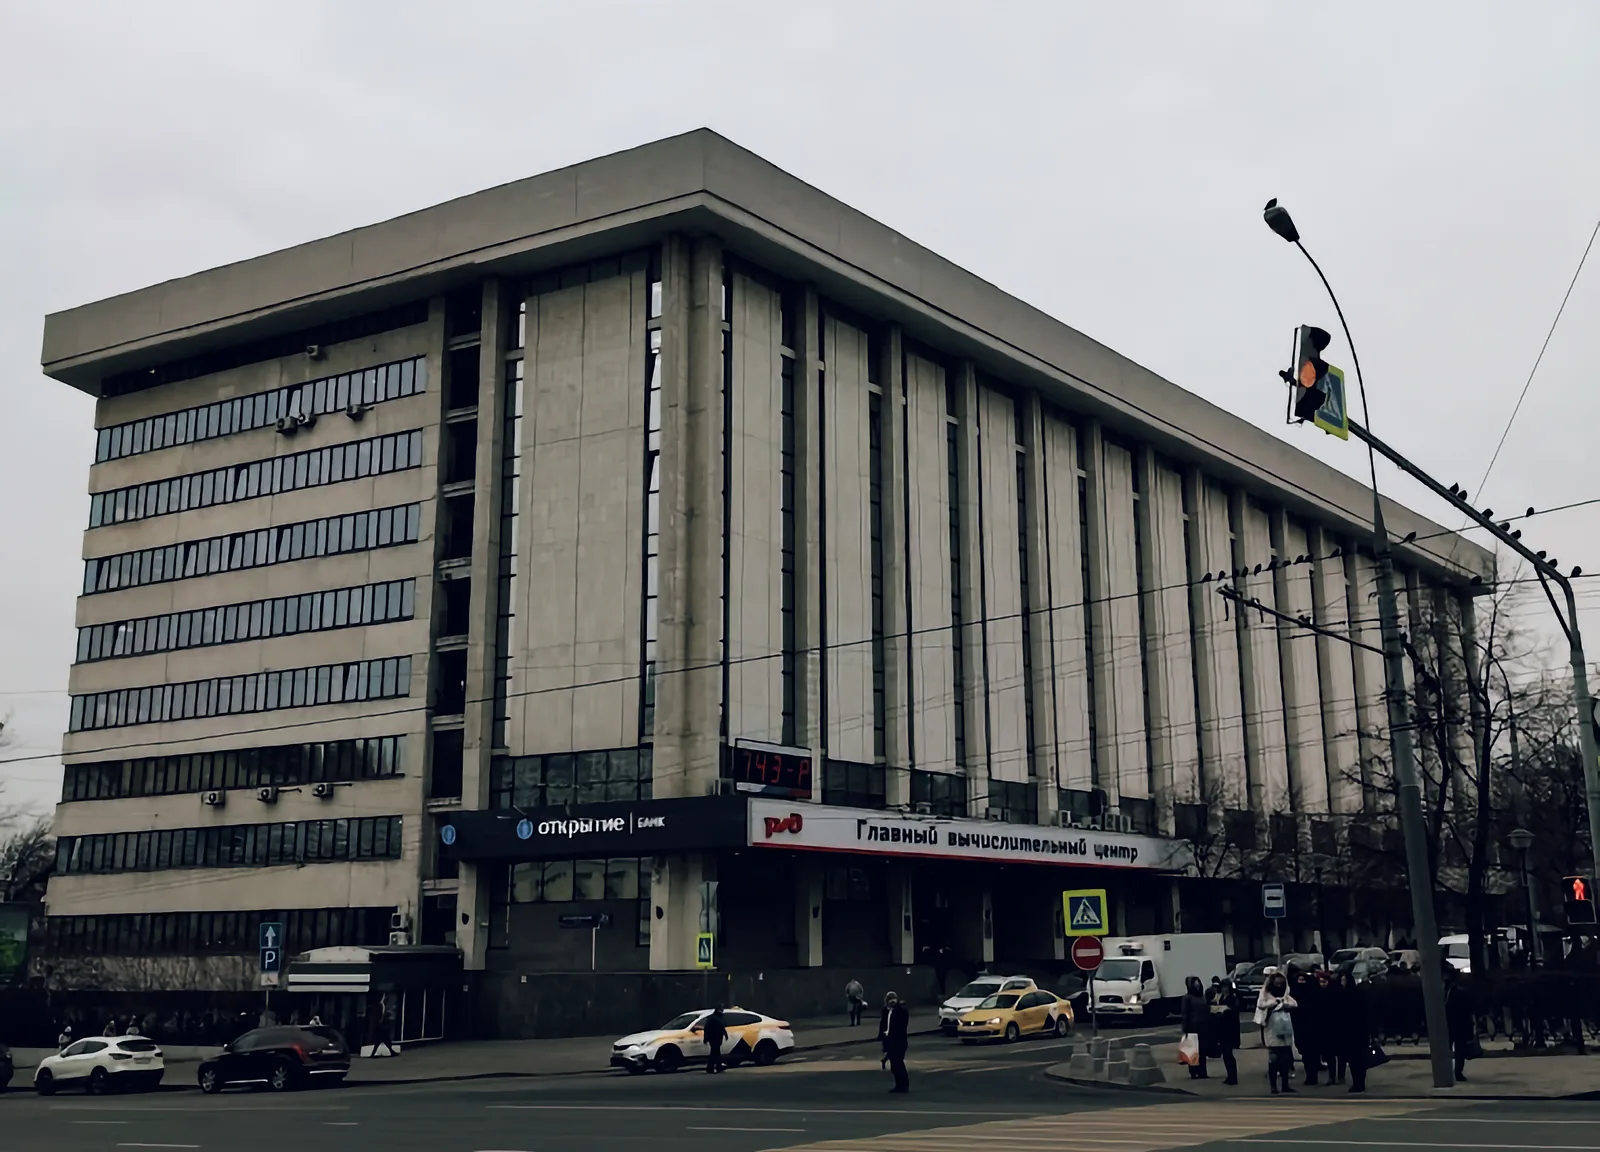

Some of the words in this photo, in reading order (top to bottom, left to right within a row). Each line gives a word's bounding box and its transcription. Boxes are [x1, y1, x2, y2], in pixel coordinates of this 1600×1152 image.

[538, 817, 625, 838] открытие
[857, 818, 938, 845] Главный
[948, 831, 1087, 855] вычислительный
[1093, 843, 1138, 863] центр
[265, 951, 276, 969] P
